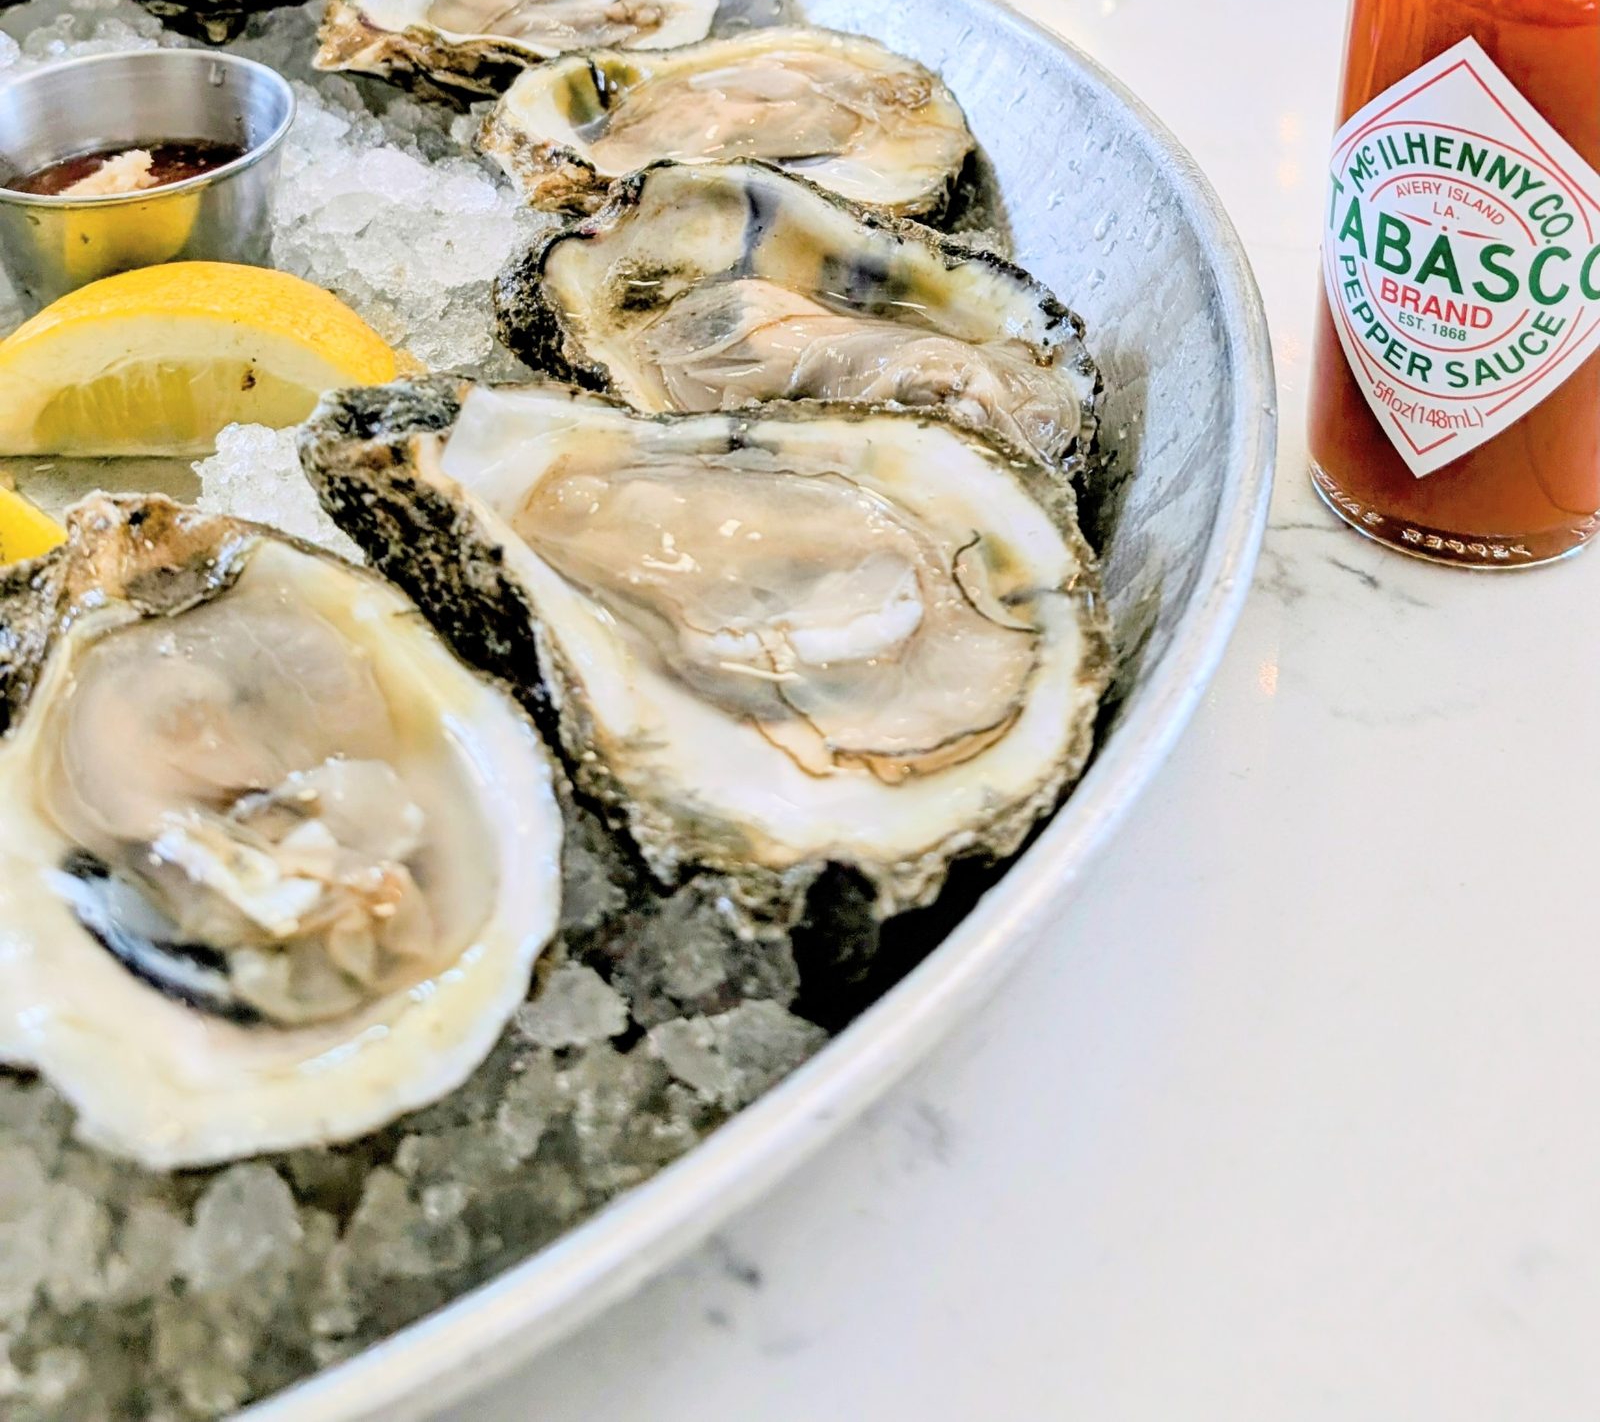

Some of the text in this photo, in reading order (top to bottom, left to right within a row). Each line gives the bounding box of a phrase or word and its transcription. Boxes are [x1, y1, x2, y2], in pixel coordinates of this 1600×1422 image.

[1395, 180, 1506, 227] AVERY ISLAND
[1339, 254, 1567, 389] PEPPER SAUCE
[1380, 276, 1494, 330] BRAND
[1397, 310, 1468, 342] EST. 1868
